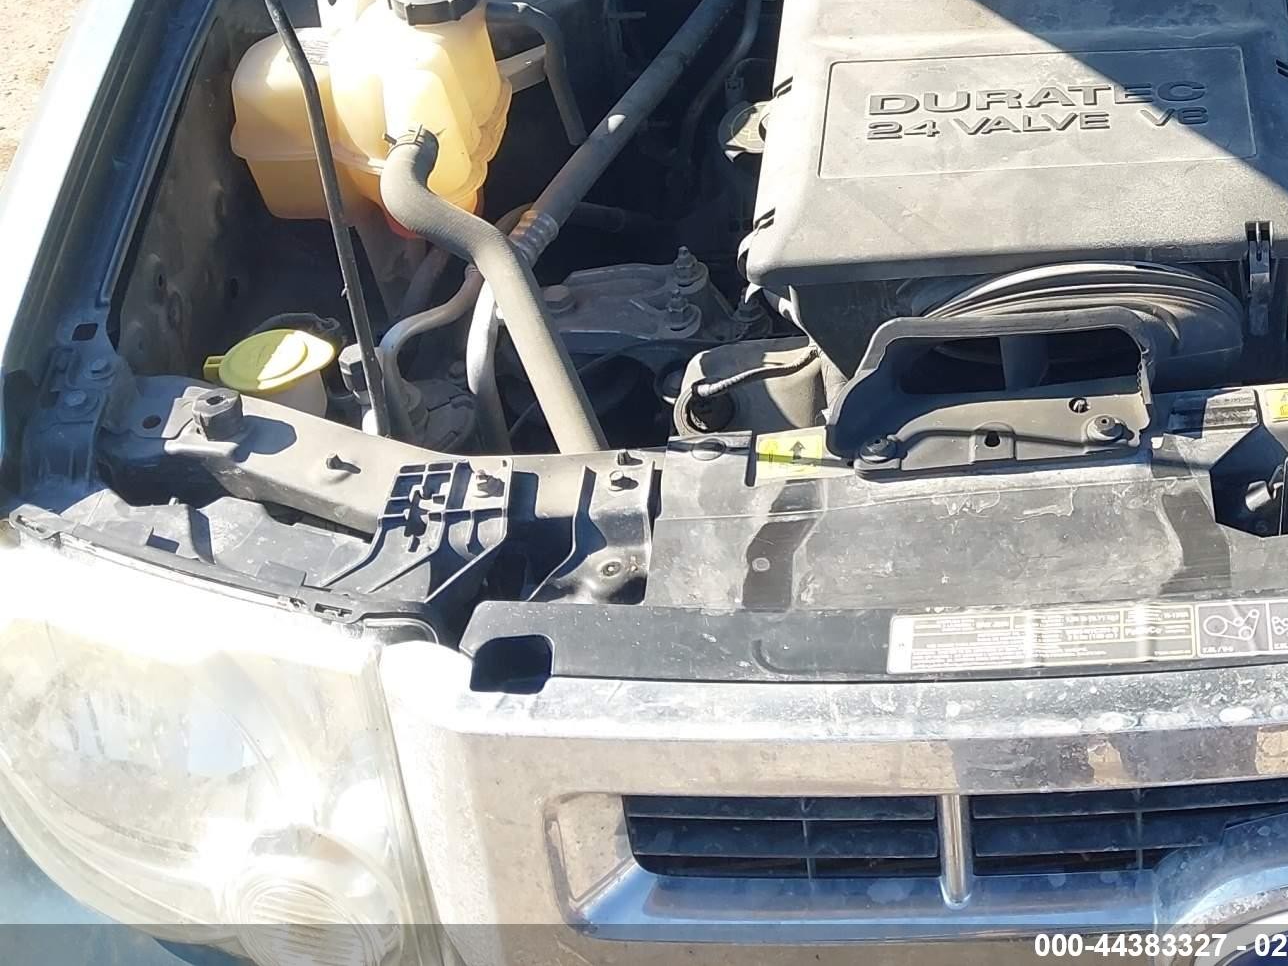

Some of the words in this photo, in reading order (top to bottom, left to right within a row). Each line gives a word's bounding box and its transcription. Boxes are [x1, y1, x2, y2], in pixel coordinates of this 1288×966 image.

[868, 81, 1207, 116] DURATEC
[866, 119, 941, 141] 24
[953, 112, 1111, 135] VALVE
[1140, 105, 1210, 128] V6
